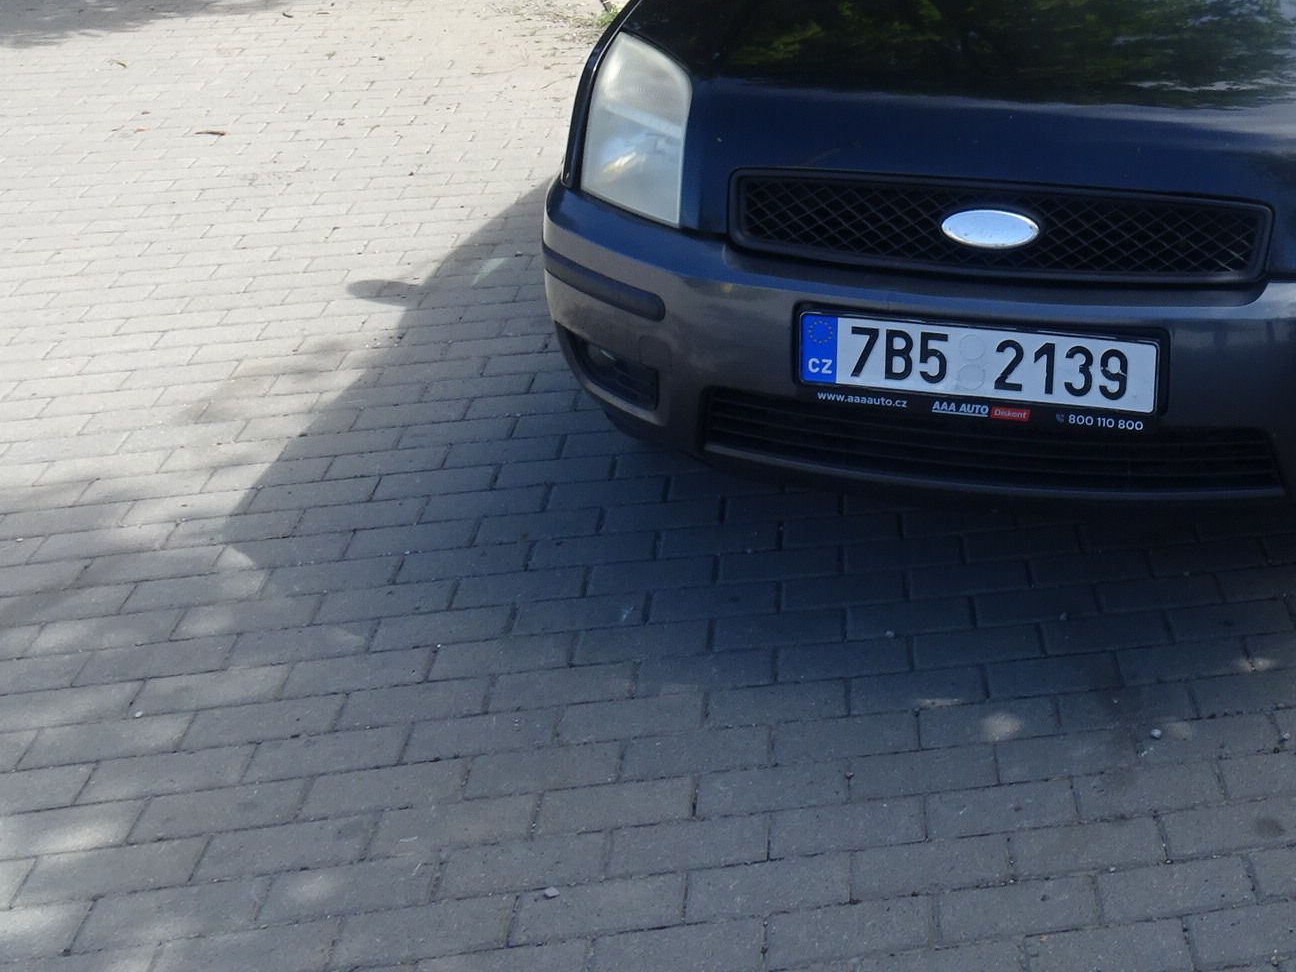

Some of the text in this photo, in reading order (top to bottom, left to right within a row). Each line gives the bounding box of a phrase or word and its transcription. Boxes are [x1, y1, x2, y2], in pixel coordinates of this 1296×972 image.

[808, 358, 833, 375] CZ
[850, 326, 1129, 402] 7B5 2139
[817, 390, 908, 408] www.aaaauto.cz
[932, 400, 989, 416] AAA AUTO
[1068, 414, 1144, 431] 800 110 800
